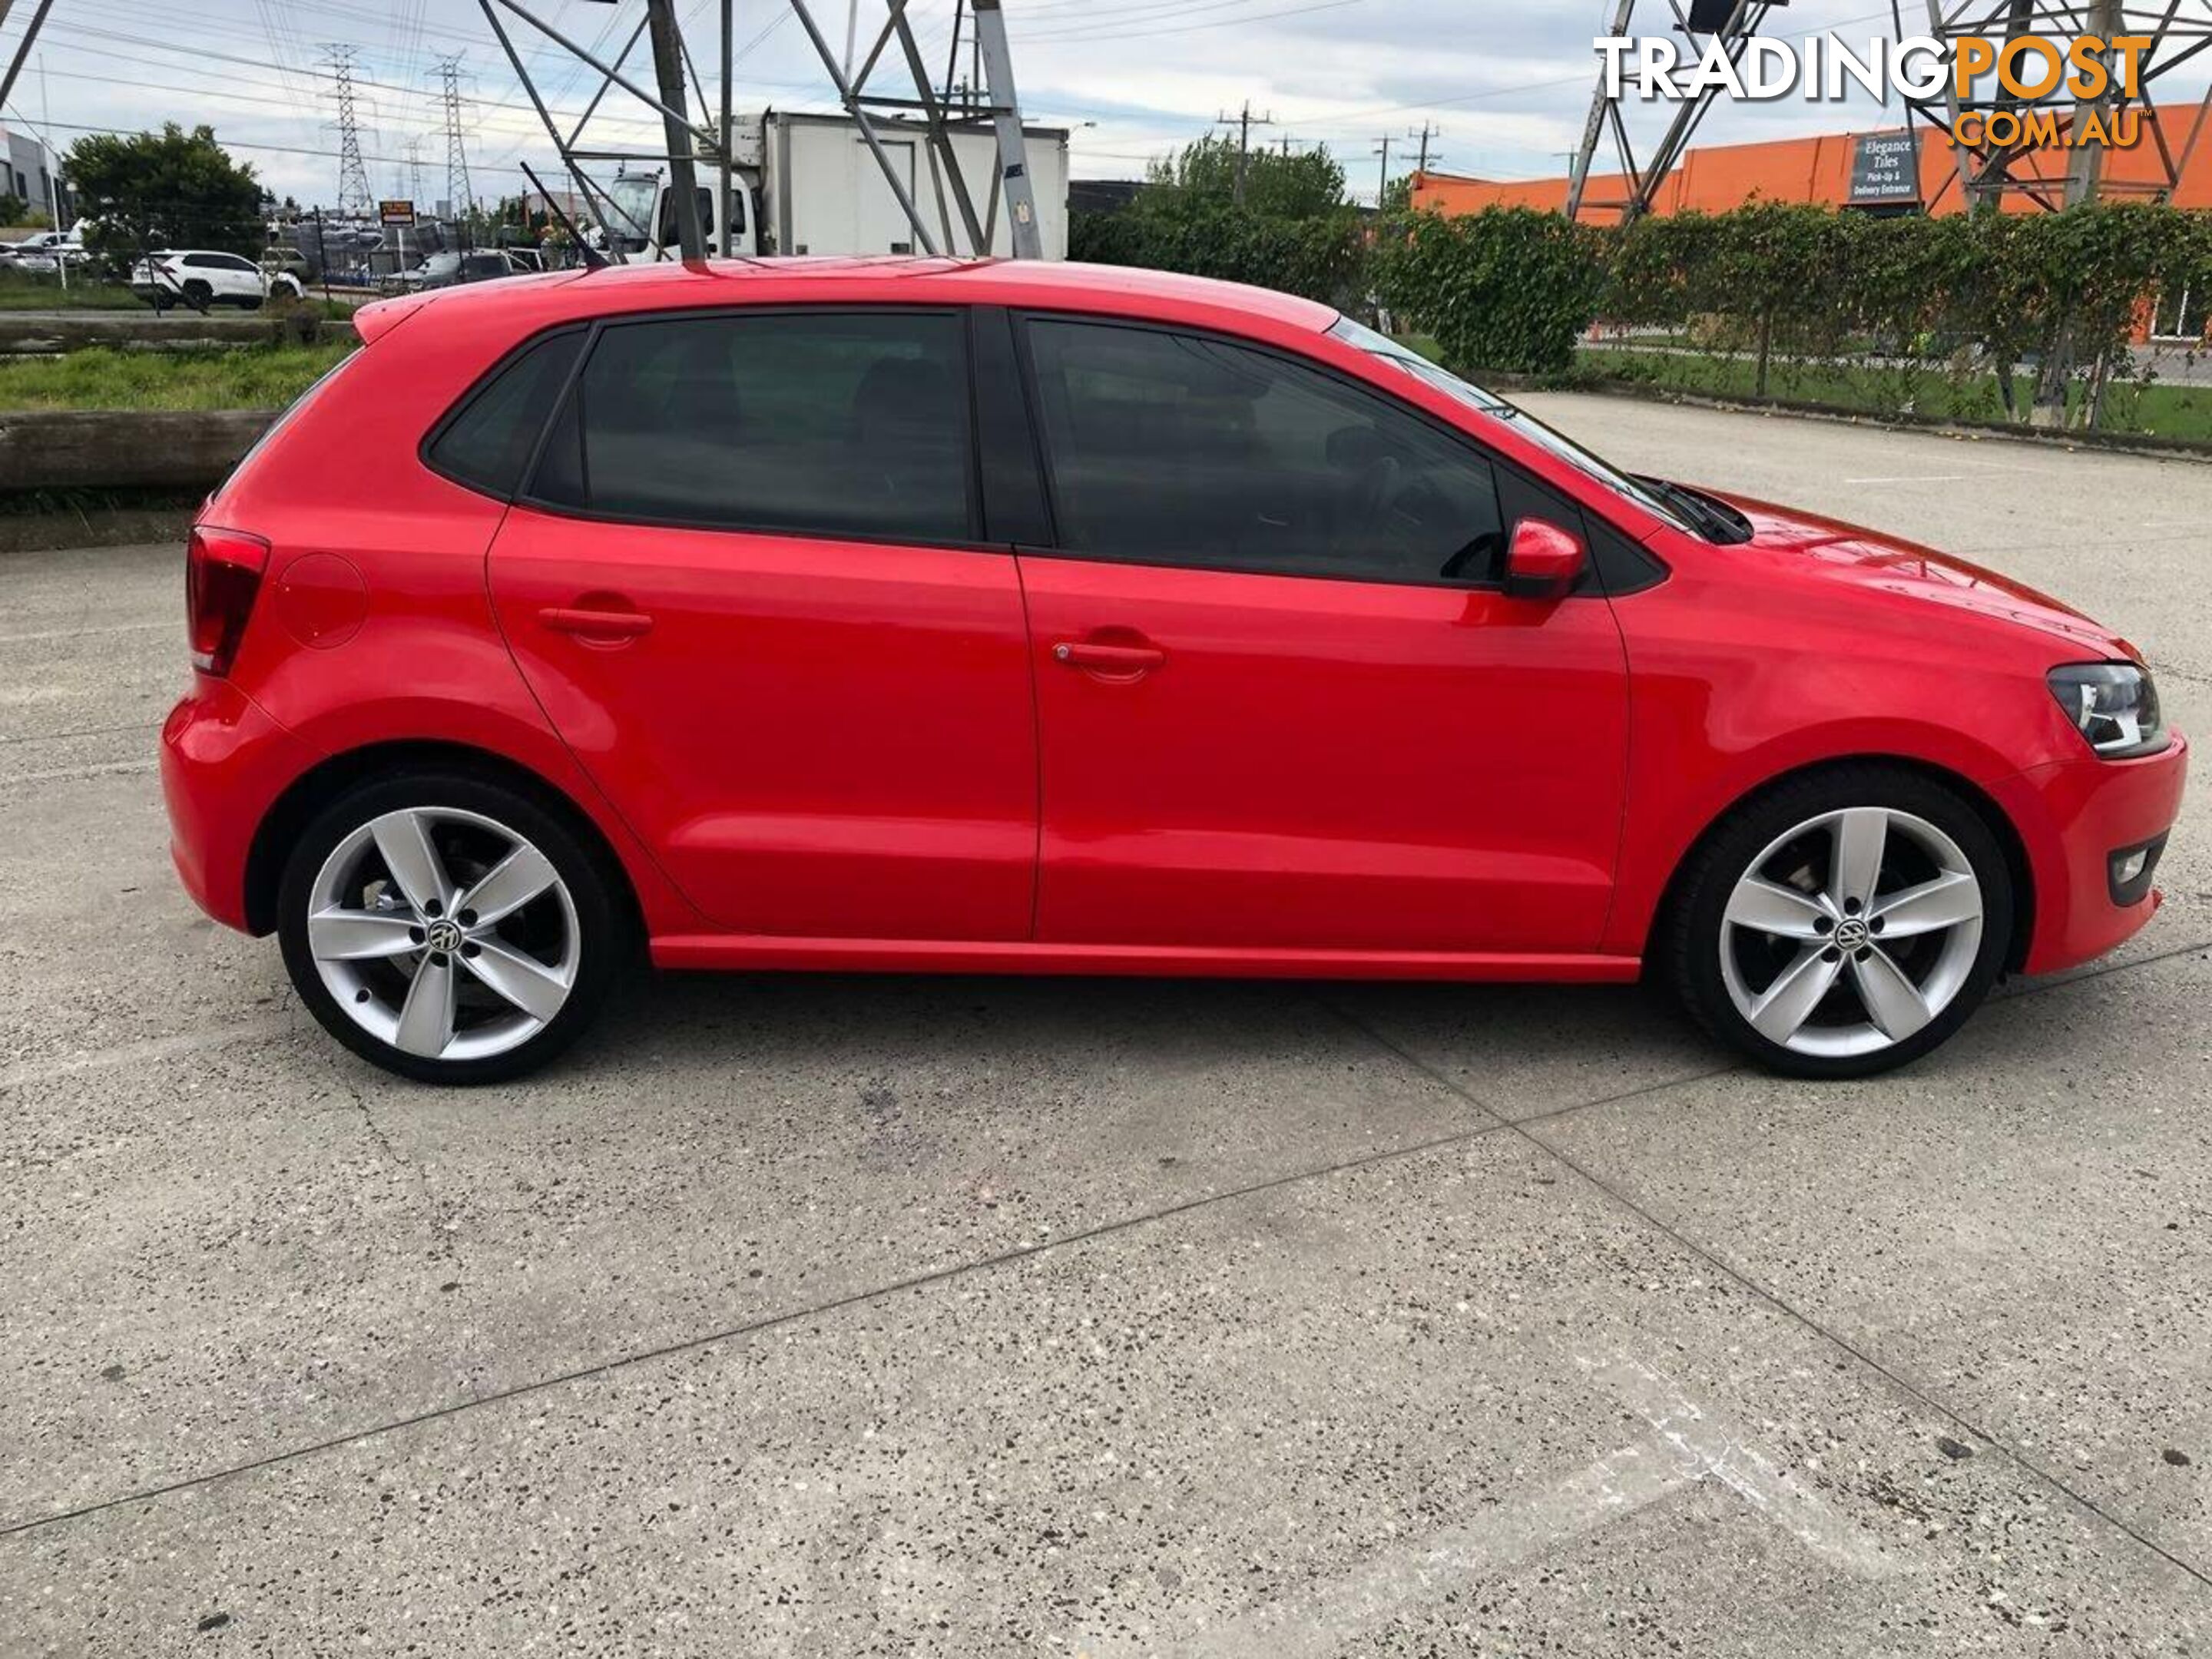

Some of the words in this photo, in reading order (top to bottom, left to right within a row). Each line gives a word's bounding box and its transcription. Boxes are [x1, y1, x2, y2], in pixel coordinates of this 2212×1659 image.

[1866, 141, 1911, 155] Elegance
[1874, 155, 1899, 168] Tiles
[1867, 172, 1893, 182] Pick-Up
[1854, 186, 1880, 196] Delivery
[1881, 184, 1911, 194] Entrance
